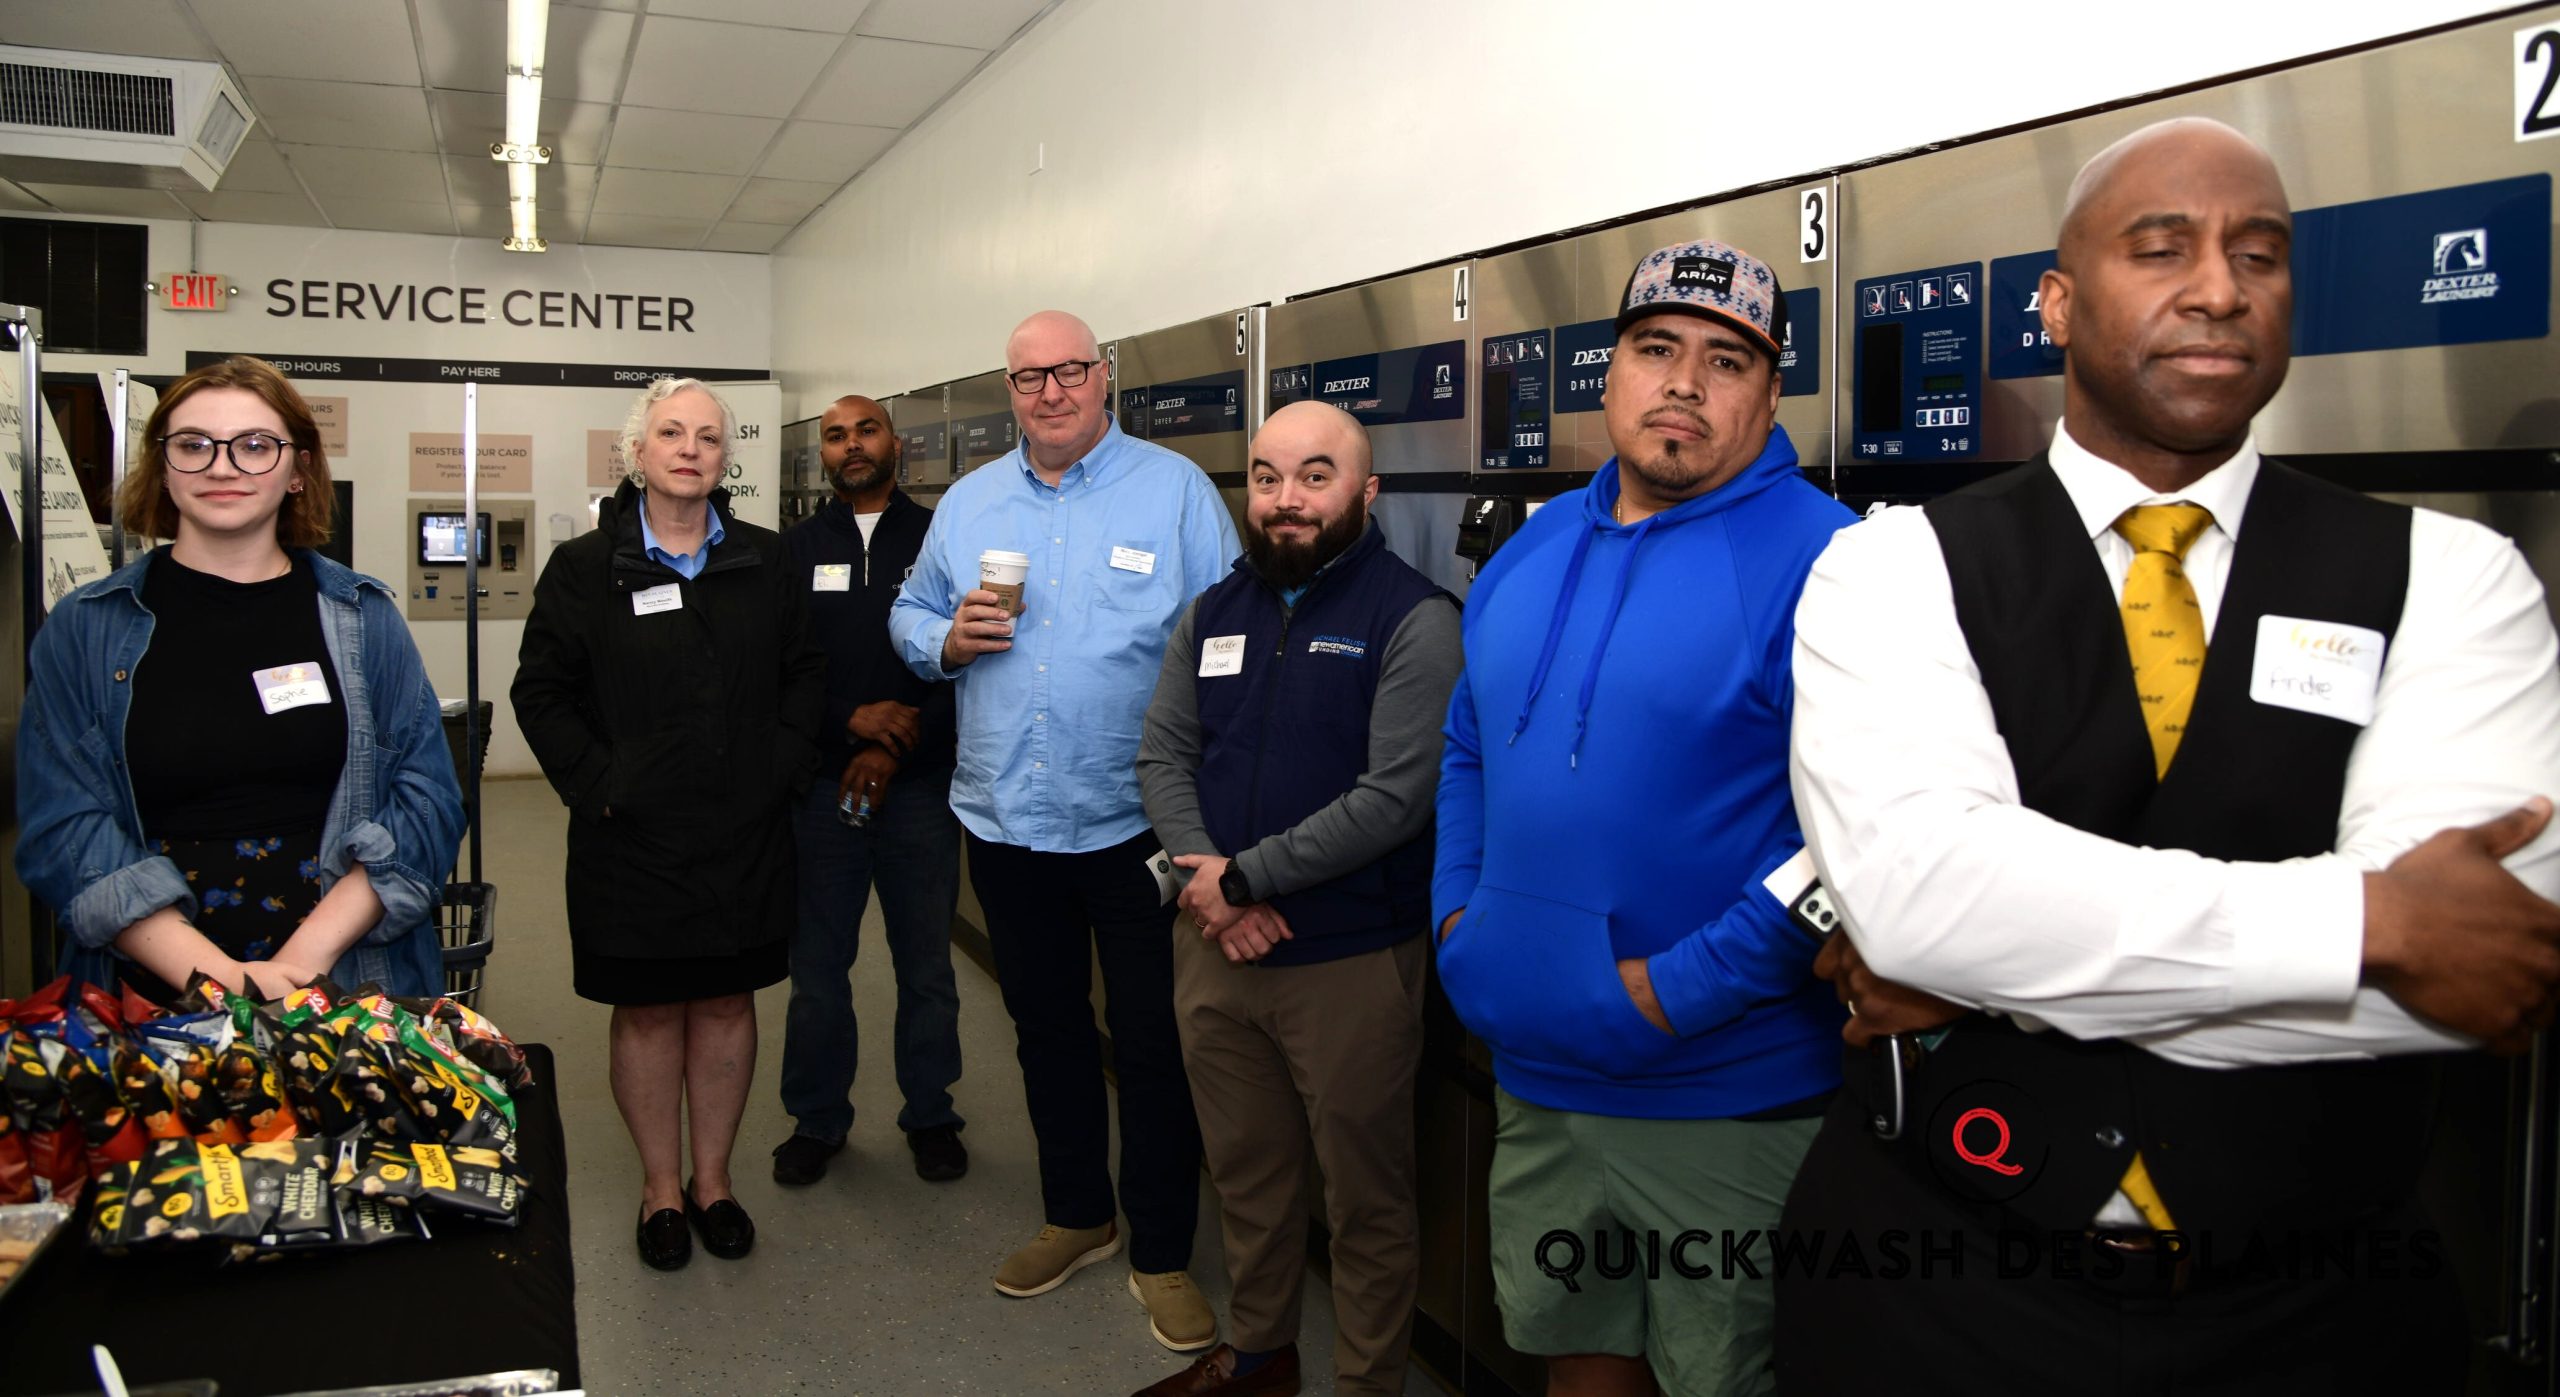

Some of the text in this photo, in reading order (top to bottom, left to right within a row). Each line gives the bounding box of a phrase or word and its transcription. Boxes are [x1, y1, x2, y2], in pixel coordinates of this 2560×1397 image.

[2523, 30, 2560, 135] 2
[1804, 192, 1824, 259] 3
[1677, 270, 1727, 285] ARIAT
[2422, 272, 2498, 292] DEXTER
[171, 275, 217, 308] EXIT
[1455, 269, 1467, 319] 4
[2420, 284, 2499, 303] LAUNDRY
[266, 278, 695, 333] SERVICE CENTER
[1237, 315, 1245, 353] 5
[1108, 348, 1114, 379] 6
[1571, 348, 1615, 366] DEX
[295, 361, 341, 373] HOURS
[441, 366, 500, 378] PAY HERE
[614, 371, 675, 382] DROP-OFF
[1323, 377, 1370, 393] DEXTER
[1571, 378, 1603, 391] DRYE
[1156, 397, 1186, 410] DEXTER
[415, 447, 528, 457] REGISTER OUR CARD
[1862, 444, 1878, 454] T-30
[1941, 438, 1949, 451] 3
[1528, 455, 1533, 465] 3
[282, 1172, 302, 1214] WHITE
[299, 1166, 319, 1220] CHEDDAR
